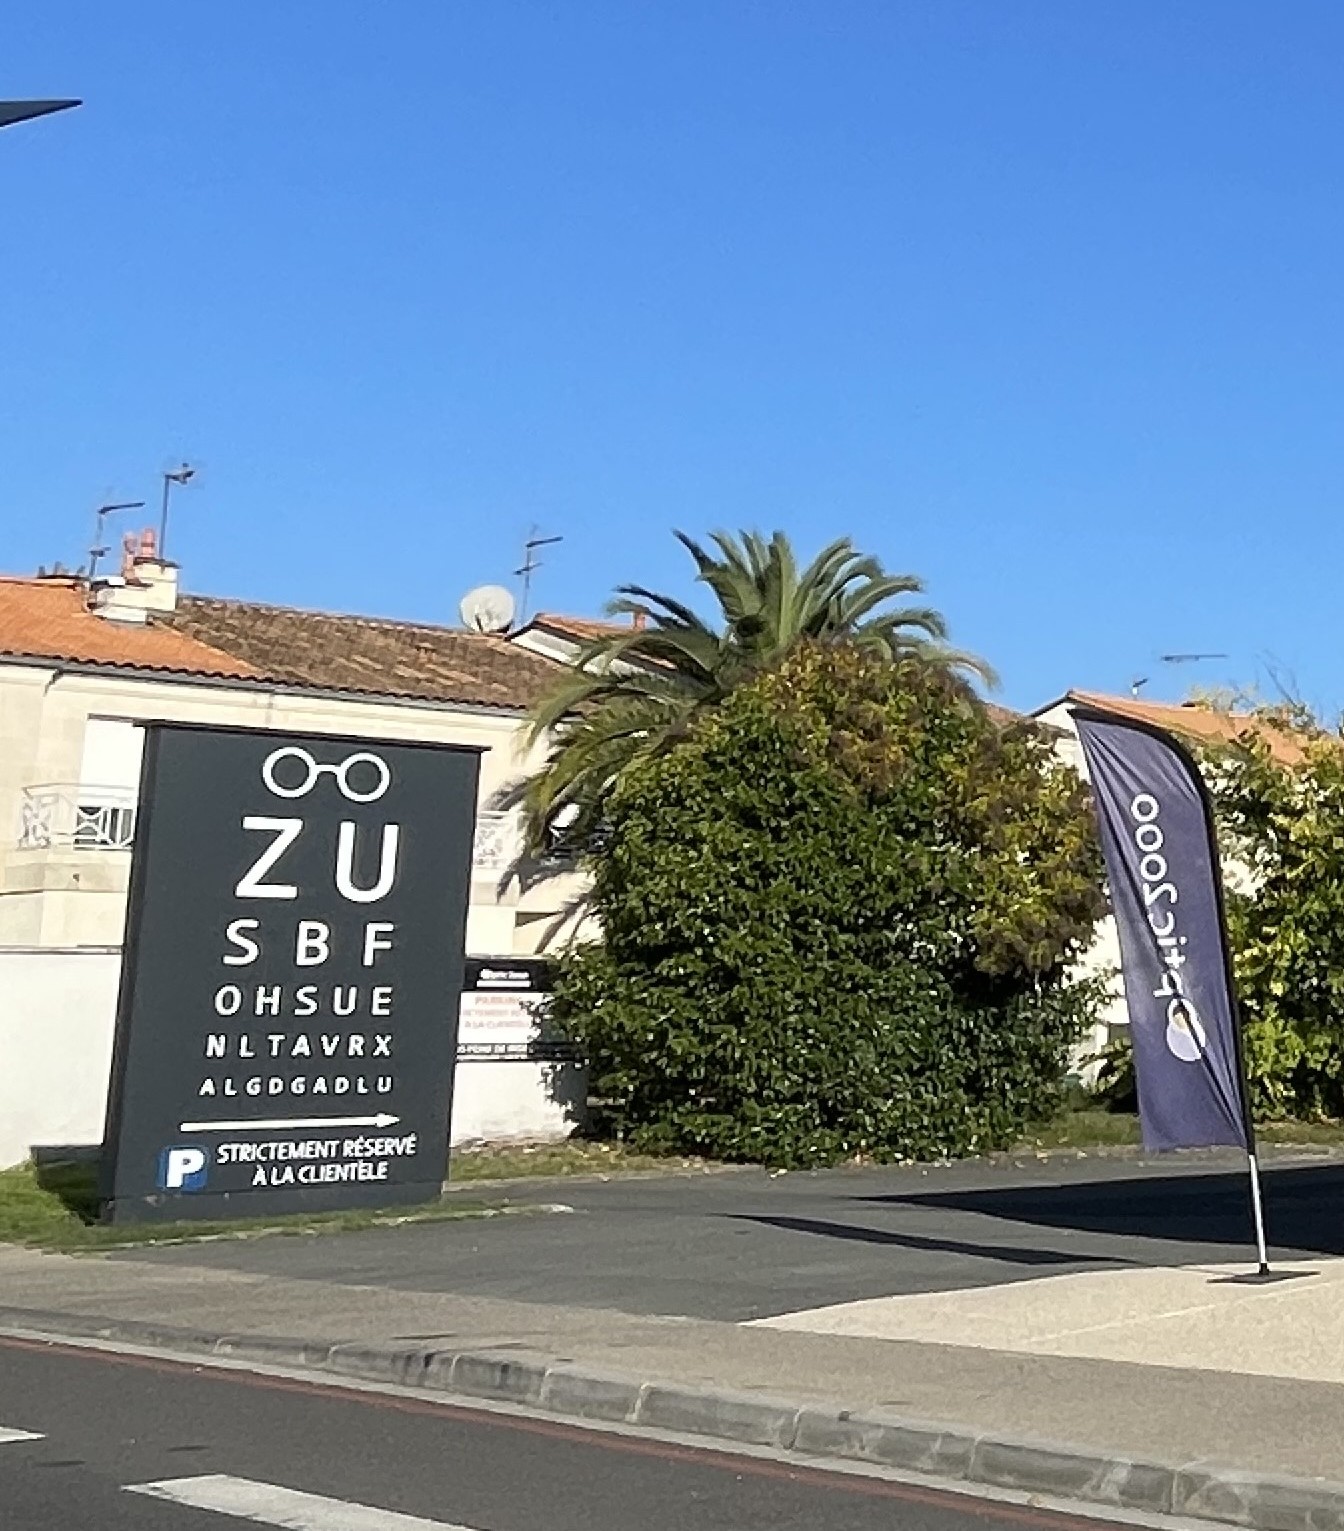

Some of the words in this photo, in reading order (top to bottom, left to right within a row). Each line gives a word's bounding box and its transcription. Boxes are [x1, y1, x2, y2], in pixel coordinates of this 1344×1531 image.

[217, 1139, 341, 1164] STRICTEMENT
[342, 1132, 417, 1159] RÉSERVÉ
[166, 1149, 204, 1188] P
[252, 1164, 267, 1187] À
[270, 1166, 295, 1186] LA
[299, 1160, 389, 1184] CLIENTÈLE
